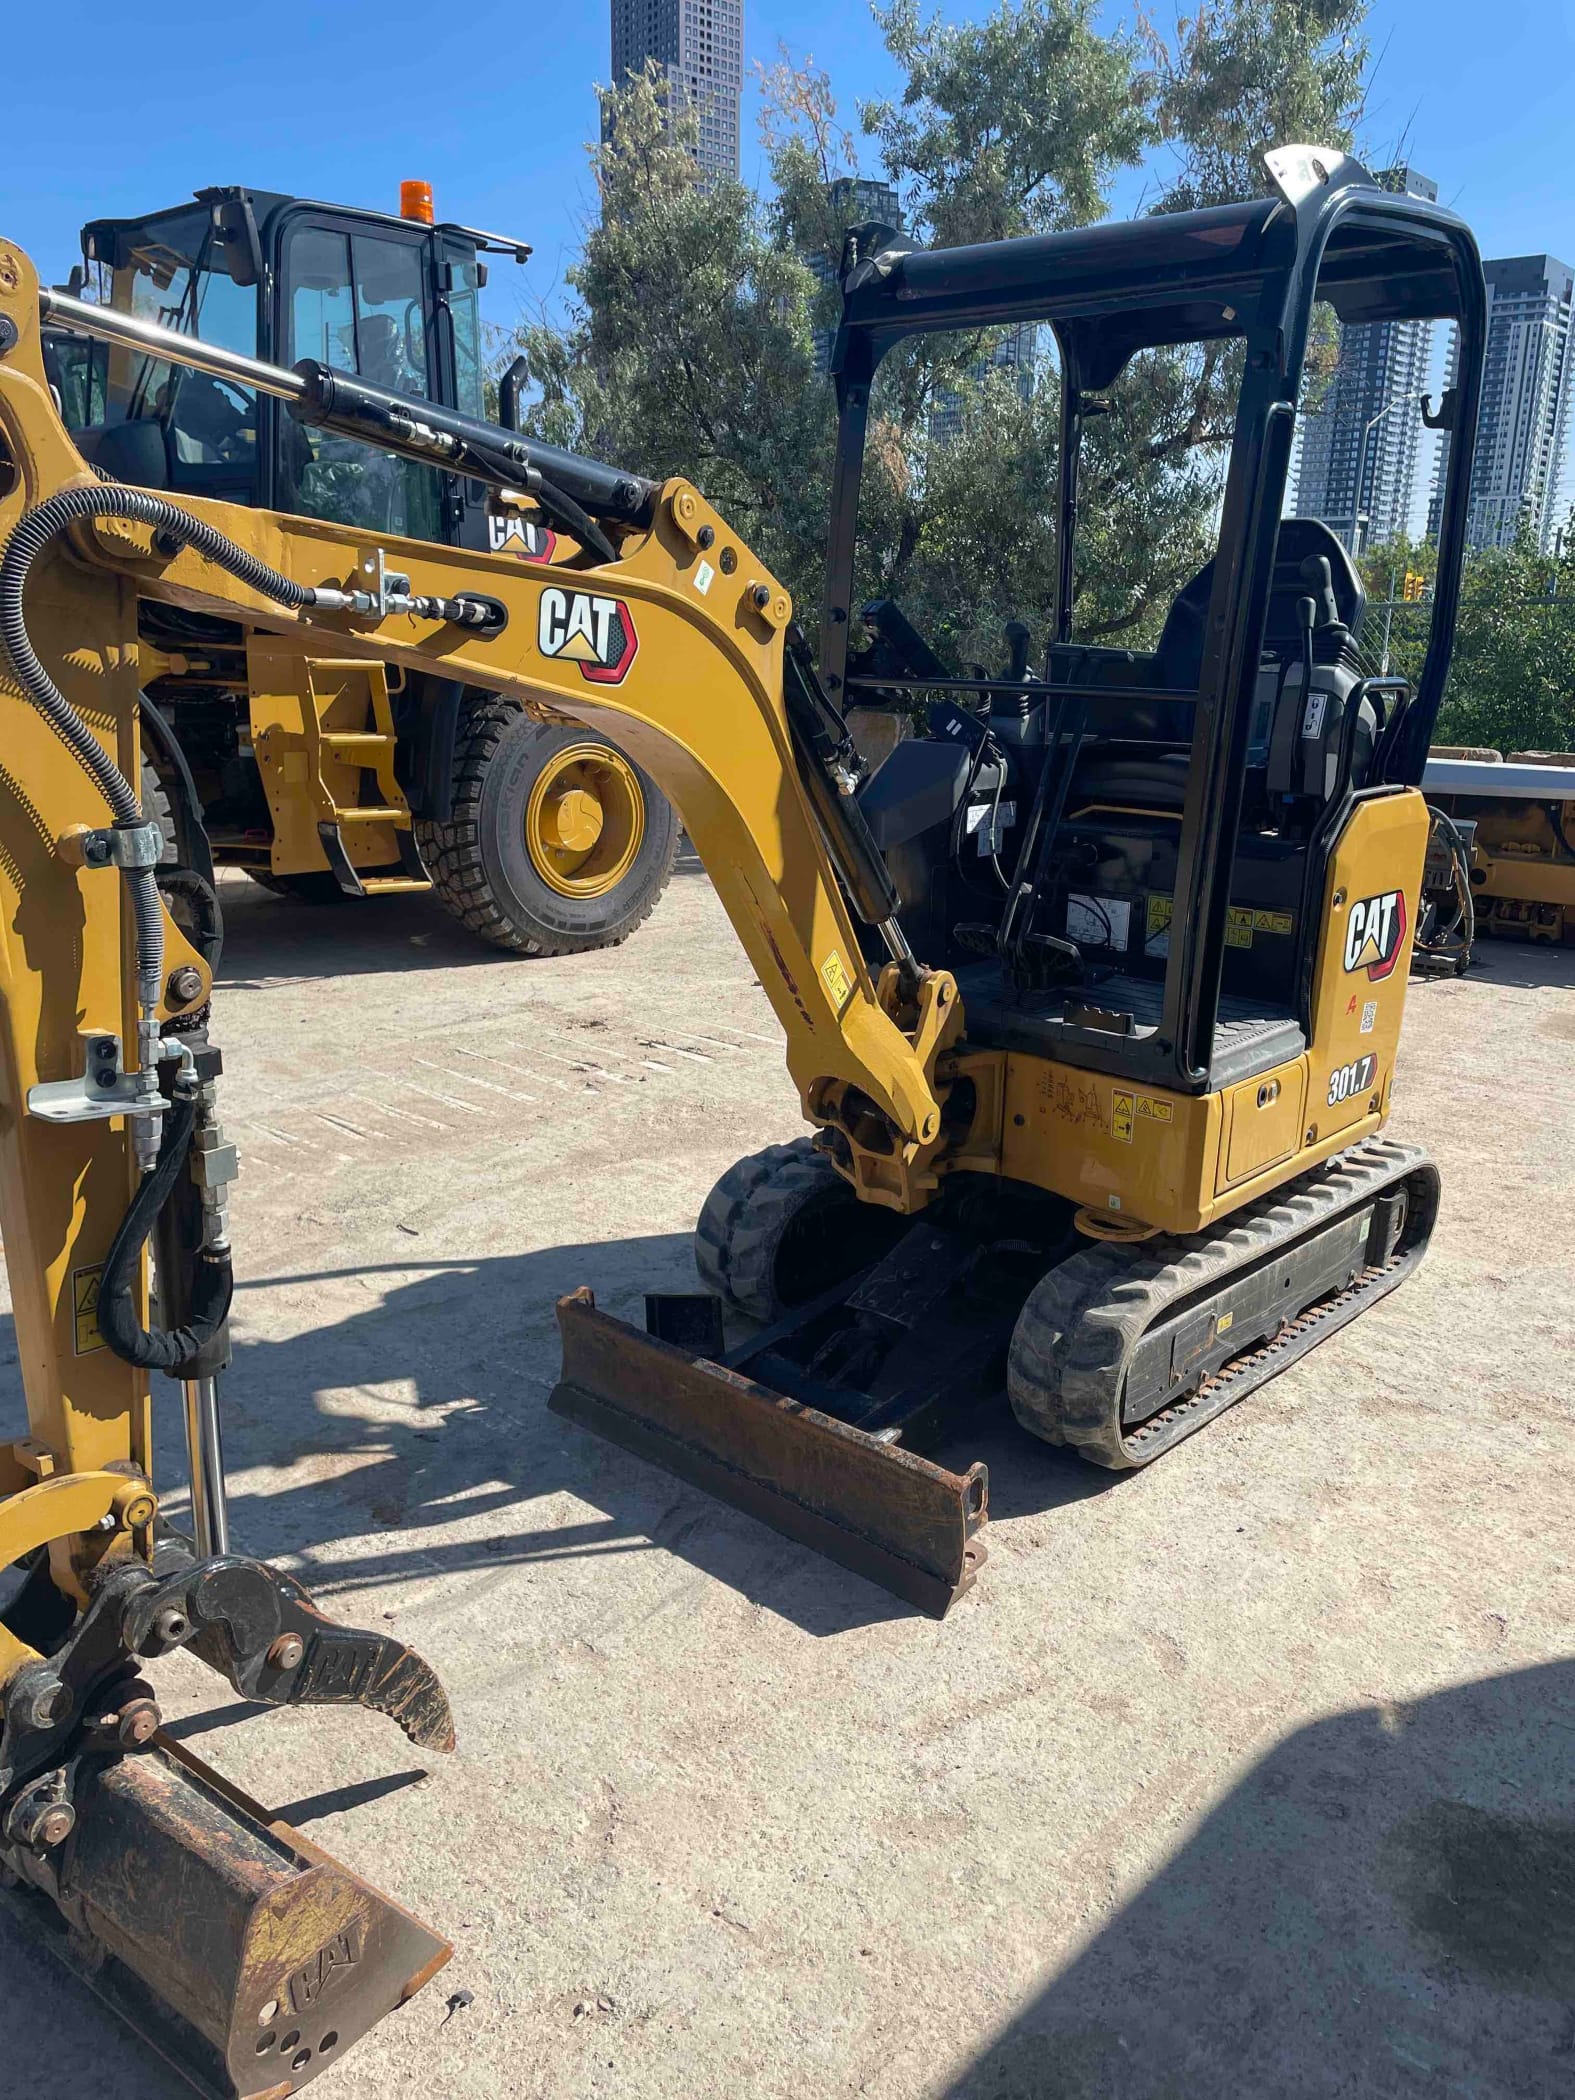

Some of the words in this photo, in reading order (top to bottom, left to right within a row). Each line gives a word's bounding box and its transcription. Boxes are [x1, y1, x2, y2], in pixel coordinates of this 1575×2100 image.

[539, 588, 616, 663] CAT
[1345, 893, 1397, 971] CAT
[1327, 1055, 1371, 1105] 301.7
[287, 1917, 361, 2014] CAT
